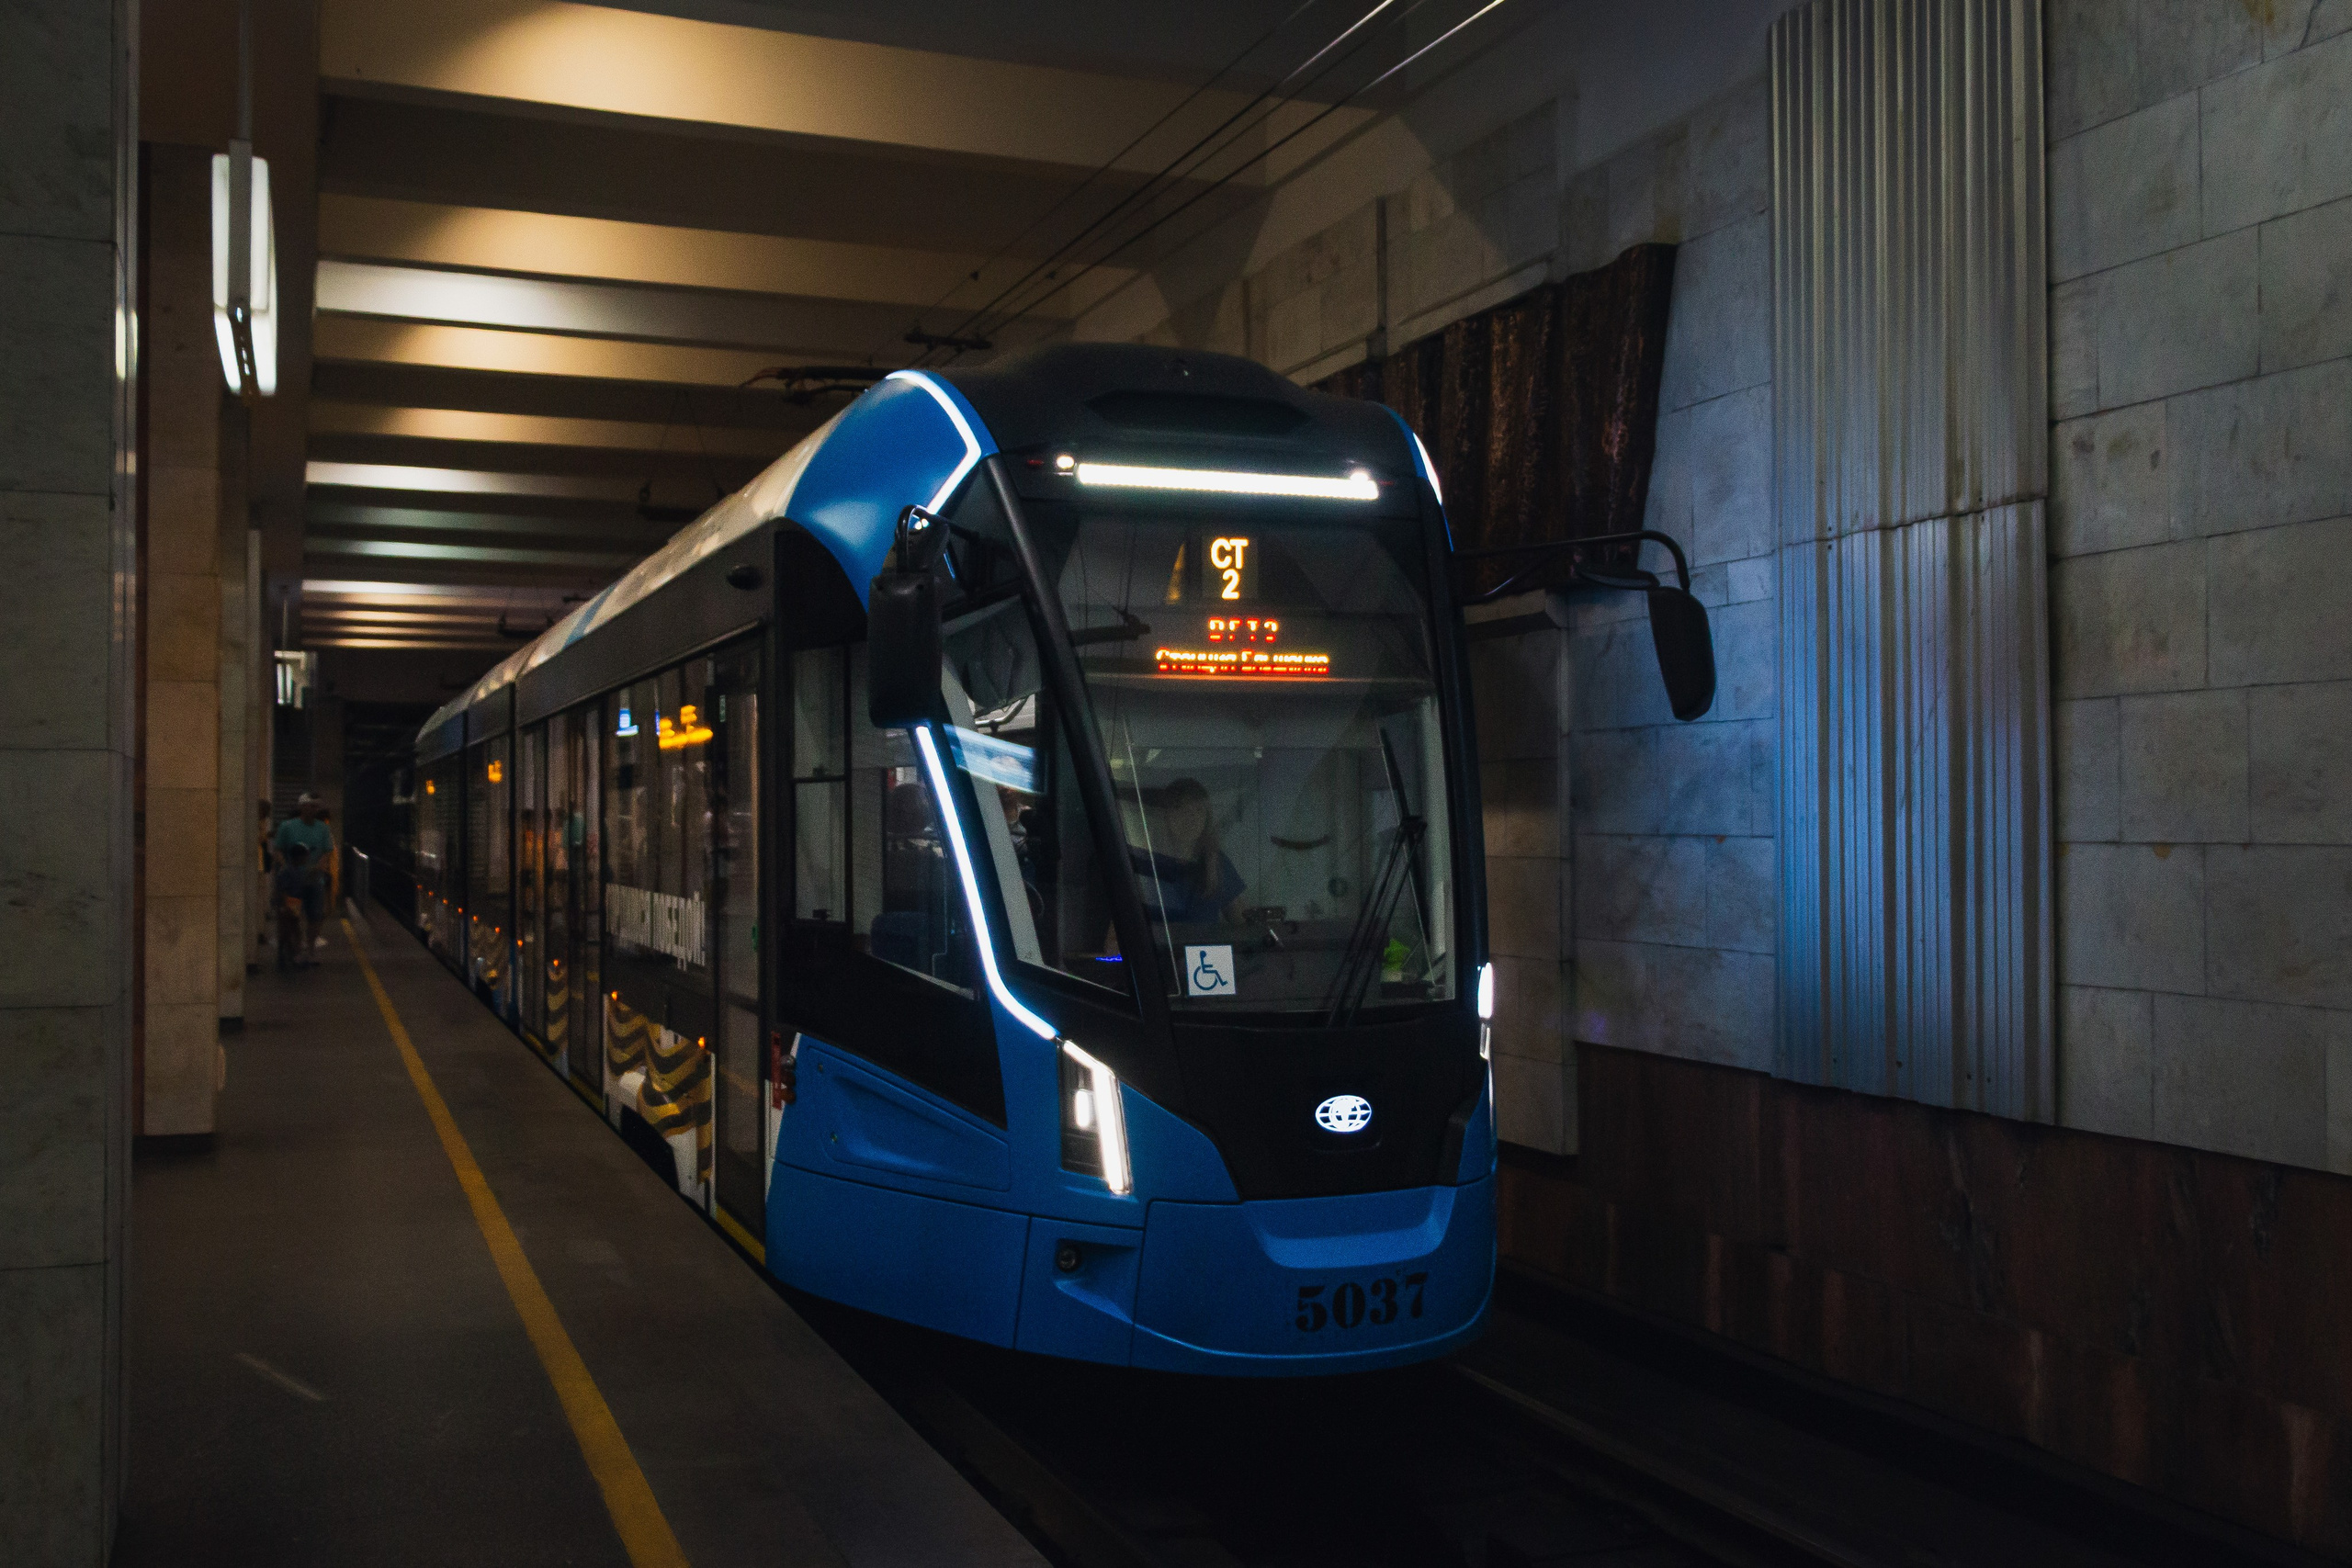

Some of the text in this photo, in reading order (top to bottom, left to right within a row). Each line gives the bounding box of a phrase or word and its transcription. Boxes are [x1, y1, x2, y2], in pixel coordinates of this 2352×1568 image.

[1209, 537, 1250, 570] СТ
[1221, 569, 1241, 600] 2
[1295, 1272, 1429, 1333] 5037
